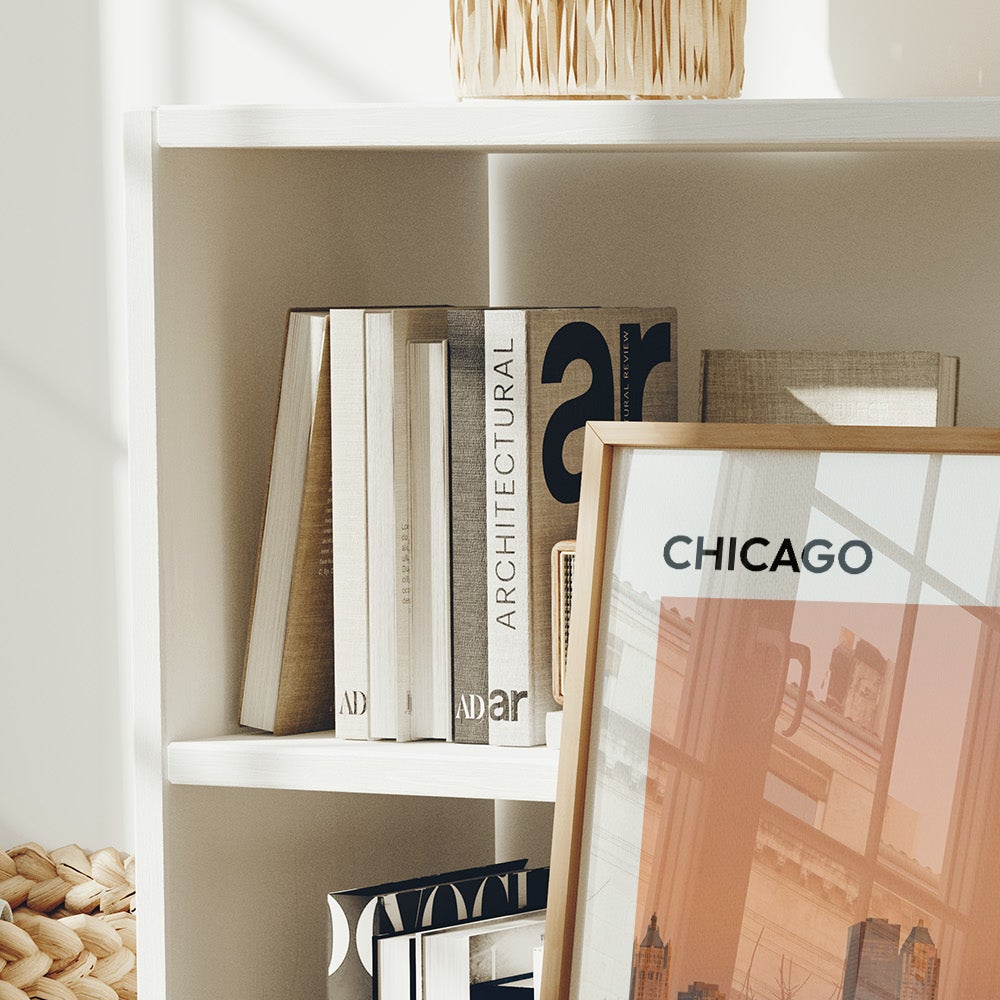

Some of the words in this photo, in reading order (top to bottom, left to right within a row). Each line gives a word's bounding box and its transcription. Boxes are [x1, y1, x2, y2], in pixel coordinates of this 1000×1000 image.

[493, 338, 516, 630] ARCHITECTURAL
[663, 535, 874, 576] CHICAGO
[339, 690, 367, 715] AD
[455, 693, 485, 720] AD
[489, 689, 528, 722] ar
